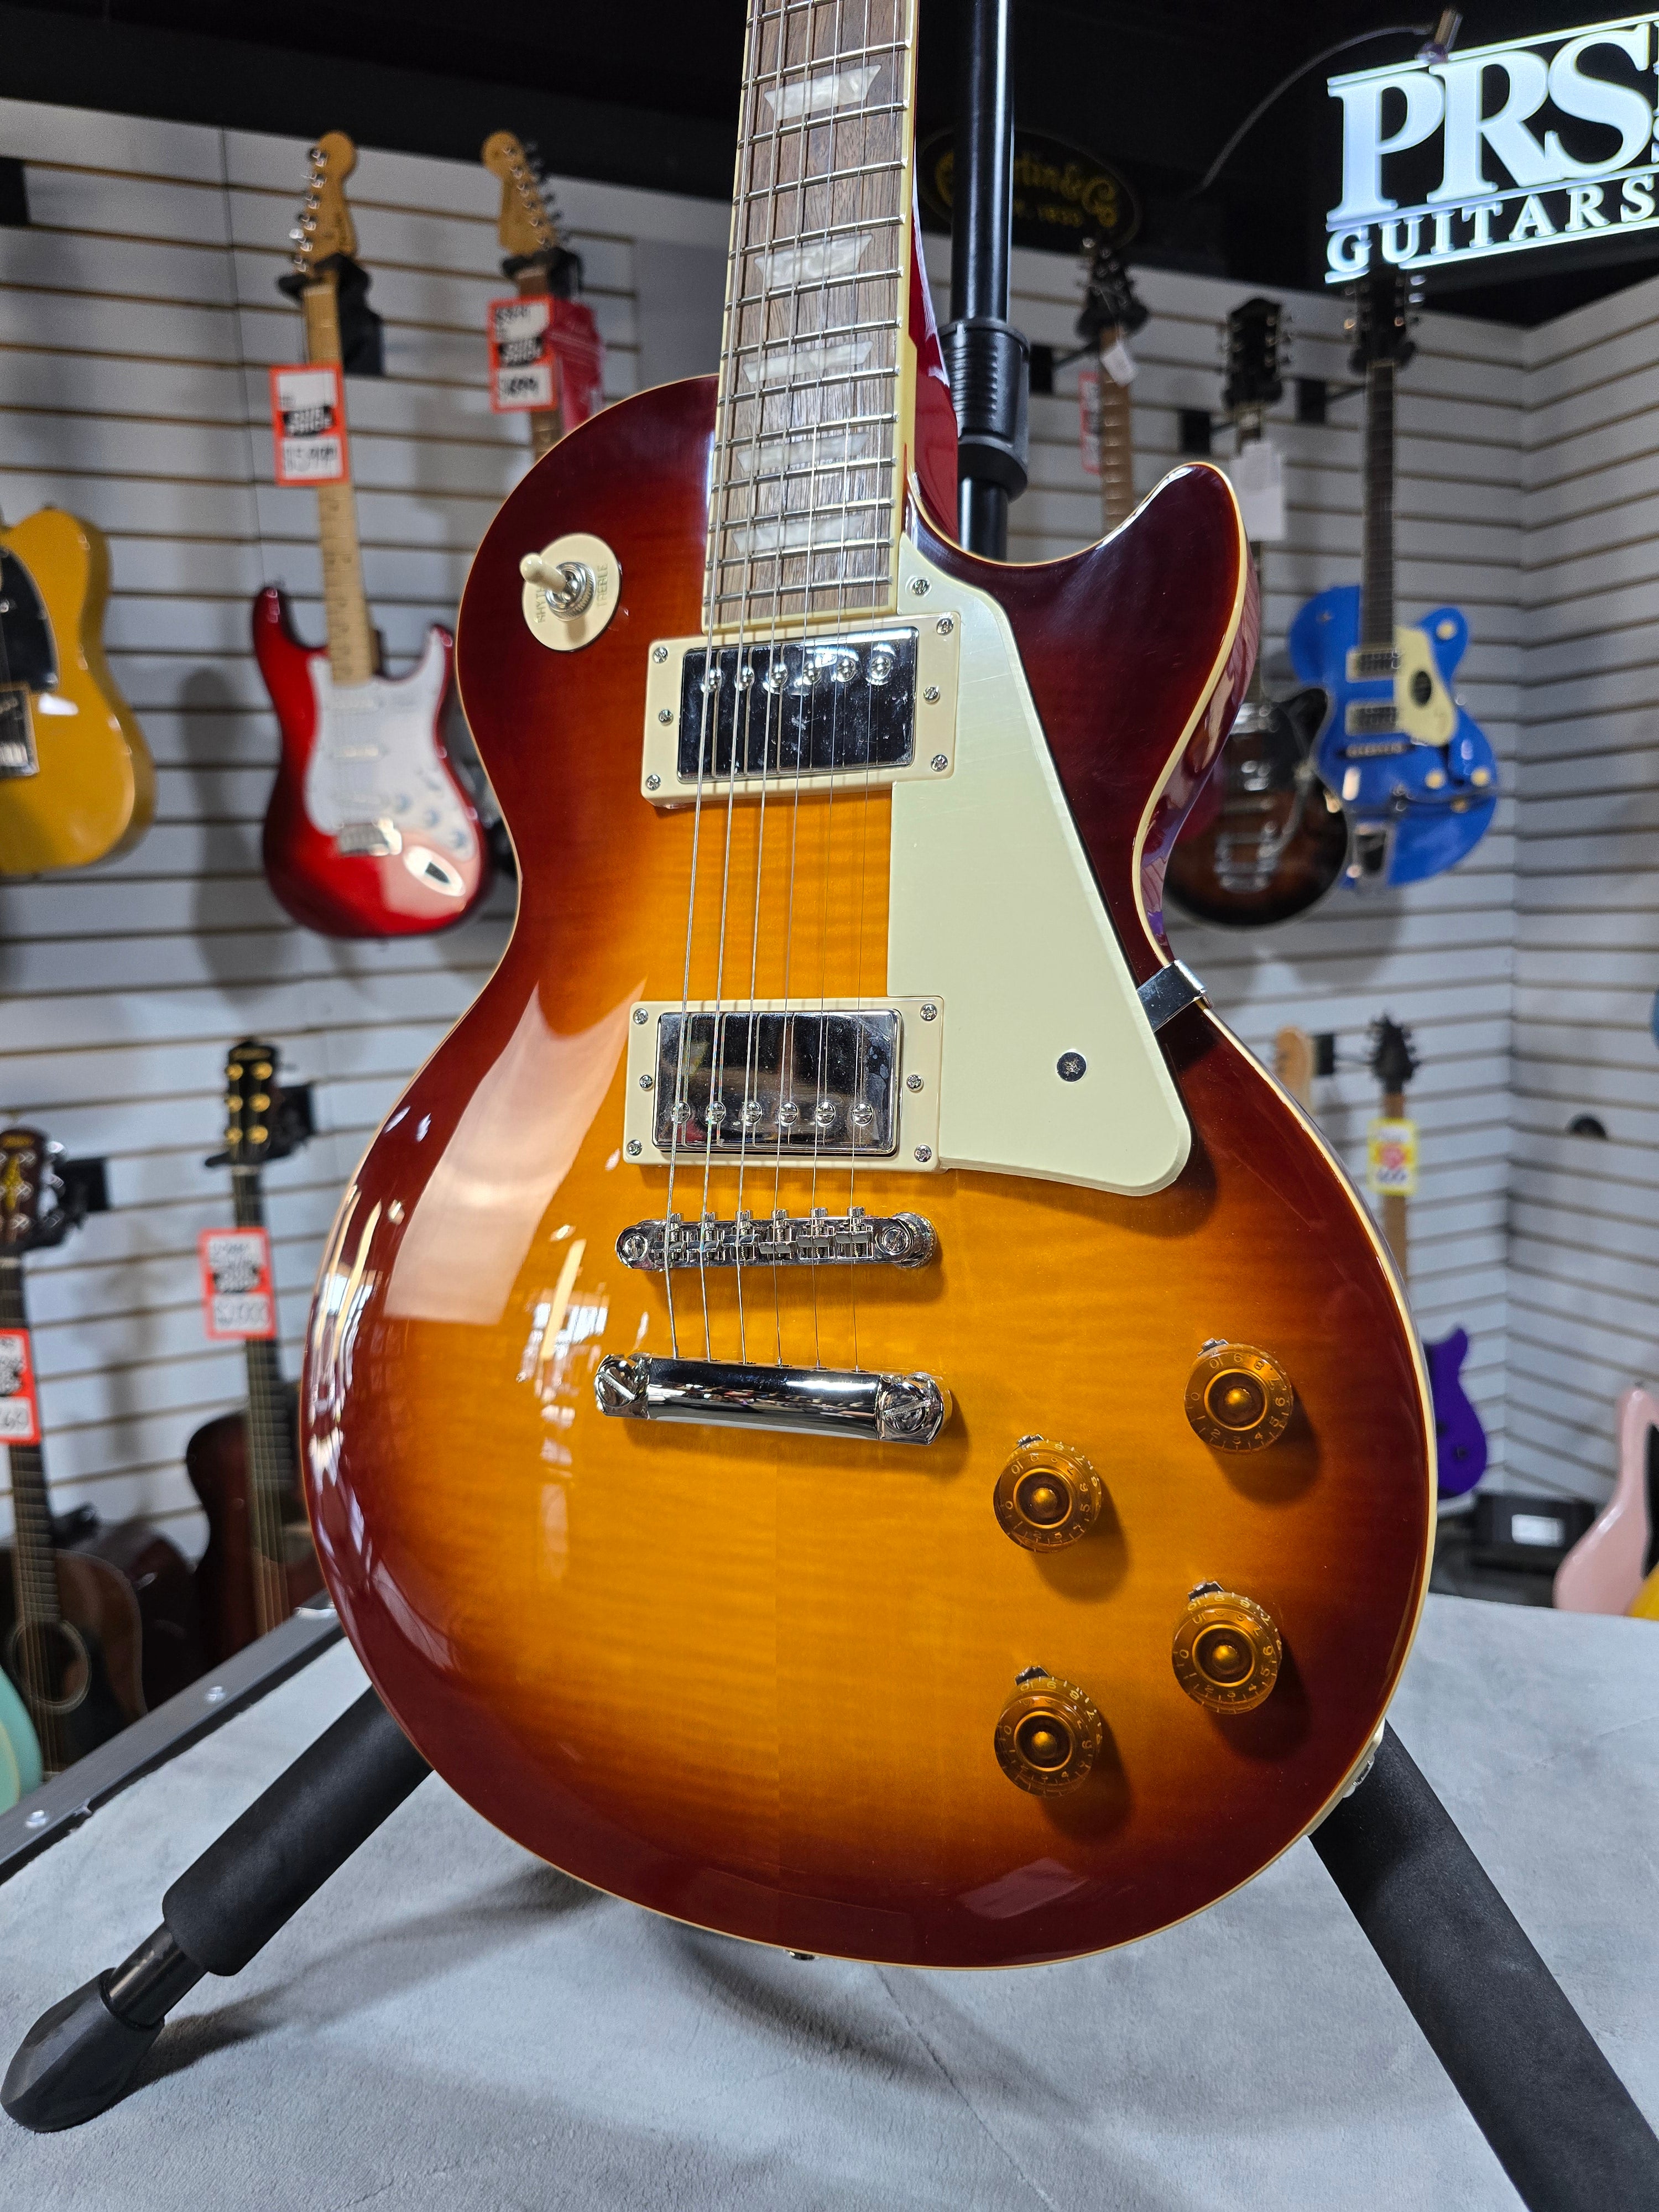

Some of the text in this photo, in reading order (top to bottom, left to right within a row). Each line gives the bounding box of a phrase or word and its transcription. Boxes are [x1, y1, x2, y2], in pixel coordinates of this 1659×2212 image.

[1327, 23, 1653, 221] PRS
[1327, 174, 1655, 273] GUITARS
[597, 562, 608, 607] TREBLE
